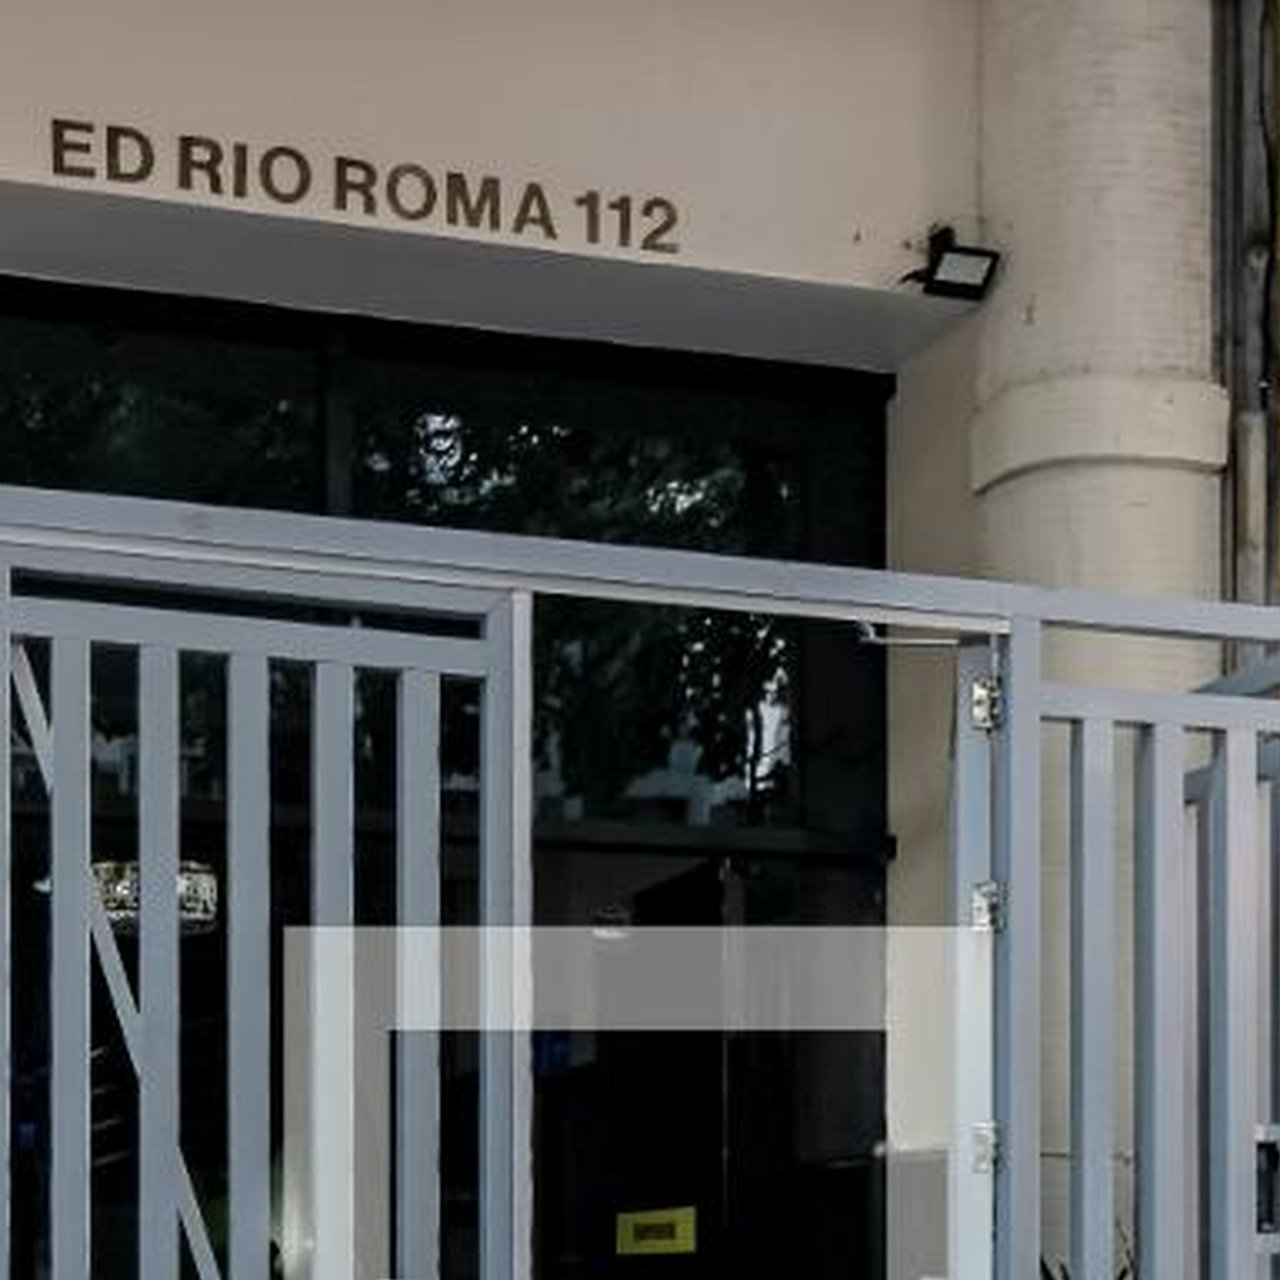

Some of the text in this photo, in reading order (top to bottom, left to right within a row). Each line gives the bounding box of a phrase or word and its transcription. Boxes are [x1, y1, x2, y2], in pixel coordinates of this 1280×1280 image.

[51, 117, 680, 254] ED RIO ROMA 112
